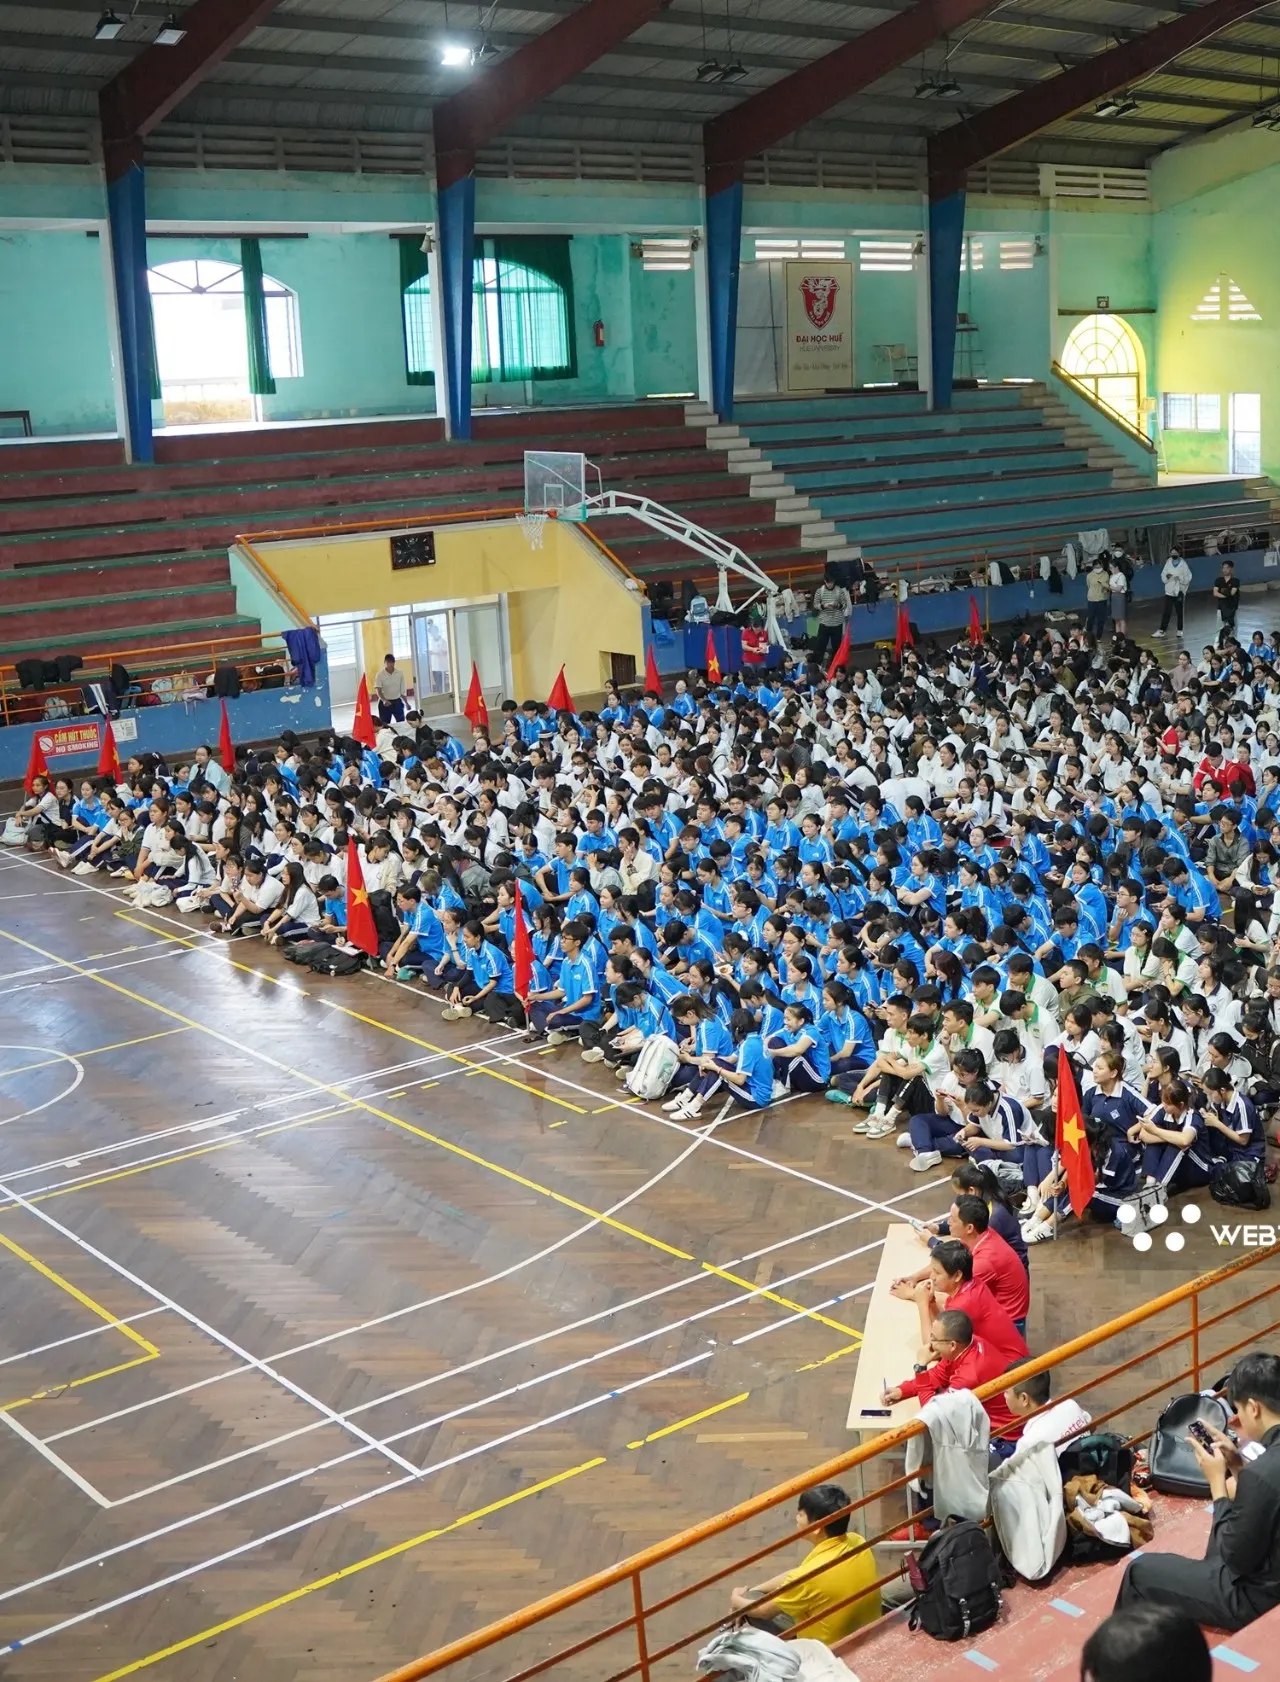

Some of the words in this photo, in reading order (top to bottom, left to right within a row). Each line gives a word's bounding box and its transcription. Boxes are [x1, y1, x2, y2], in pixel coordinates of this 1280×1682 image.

[796, 335, 809, 344] ĐẠI
[810, 335, 828, 345] HỌC
[829, 331, 844, 343] HUẾ
[55, 745, 66, 753] NO
[67, 741, 99, 752] SMOKING
